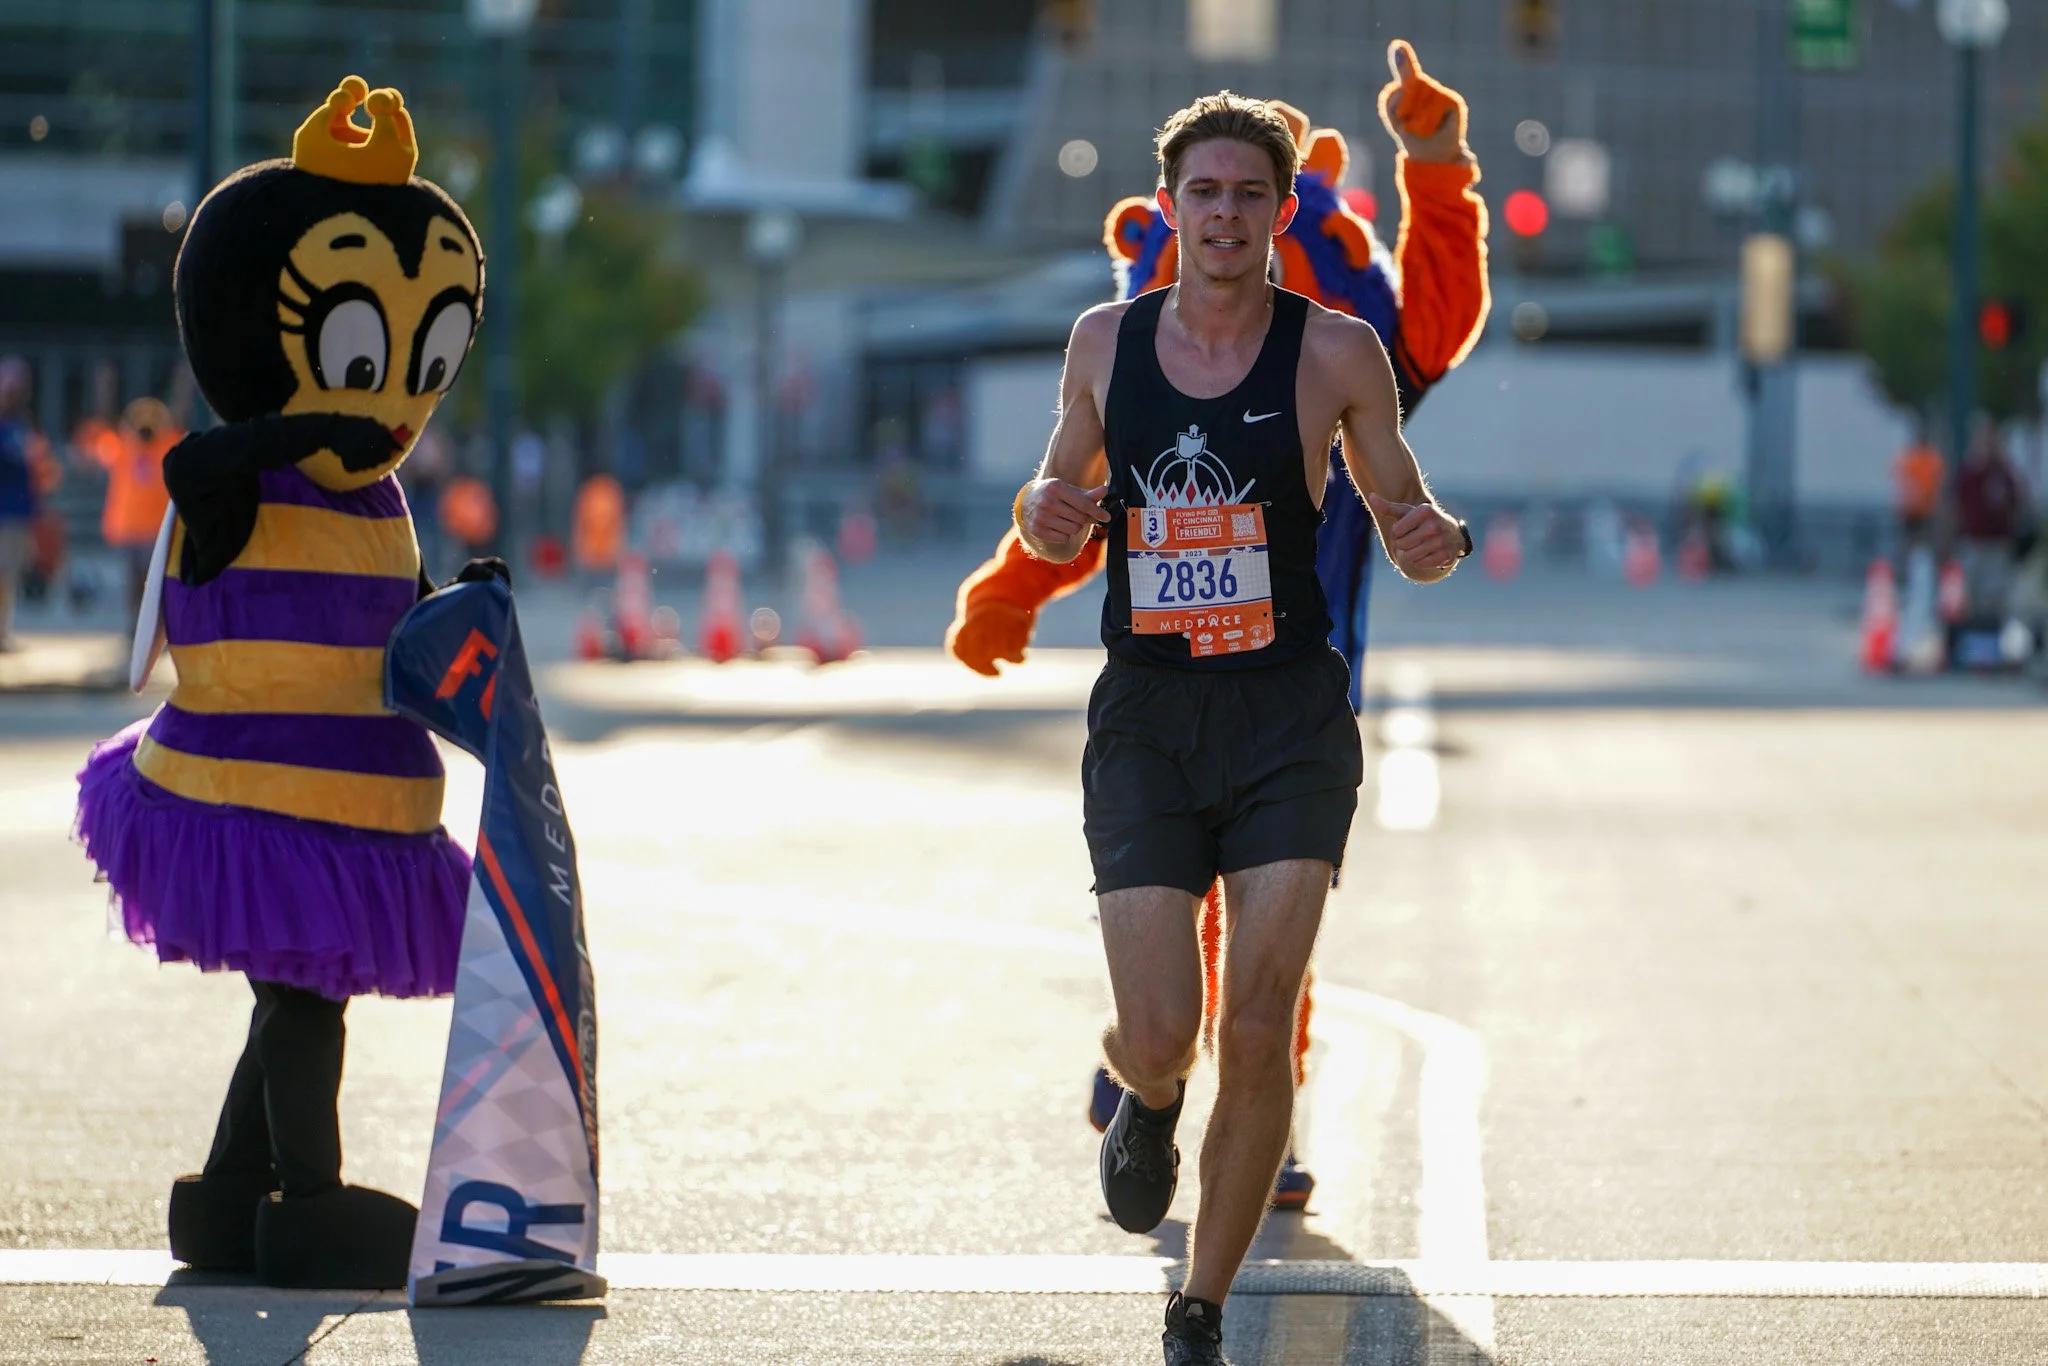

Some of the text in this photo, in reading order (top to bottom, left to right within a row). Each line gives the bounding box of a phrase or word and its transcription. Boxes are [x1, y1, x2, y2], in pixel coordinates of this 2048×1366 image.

[1149, 517, 1158, 532] 3
[1183, 515, 1224, 525] CINCINNATI
[1179, 526, 1217, 538] FRIENDLY
[1155, 558, 1238, 603] 2836
[1160, 614, 1241, 631] MEDPACE
